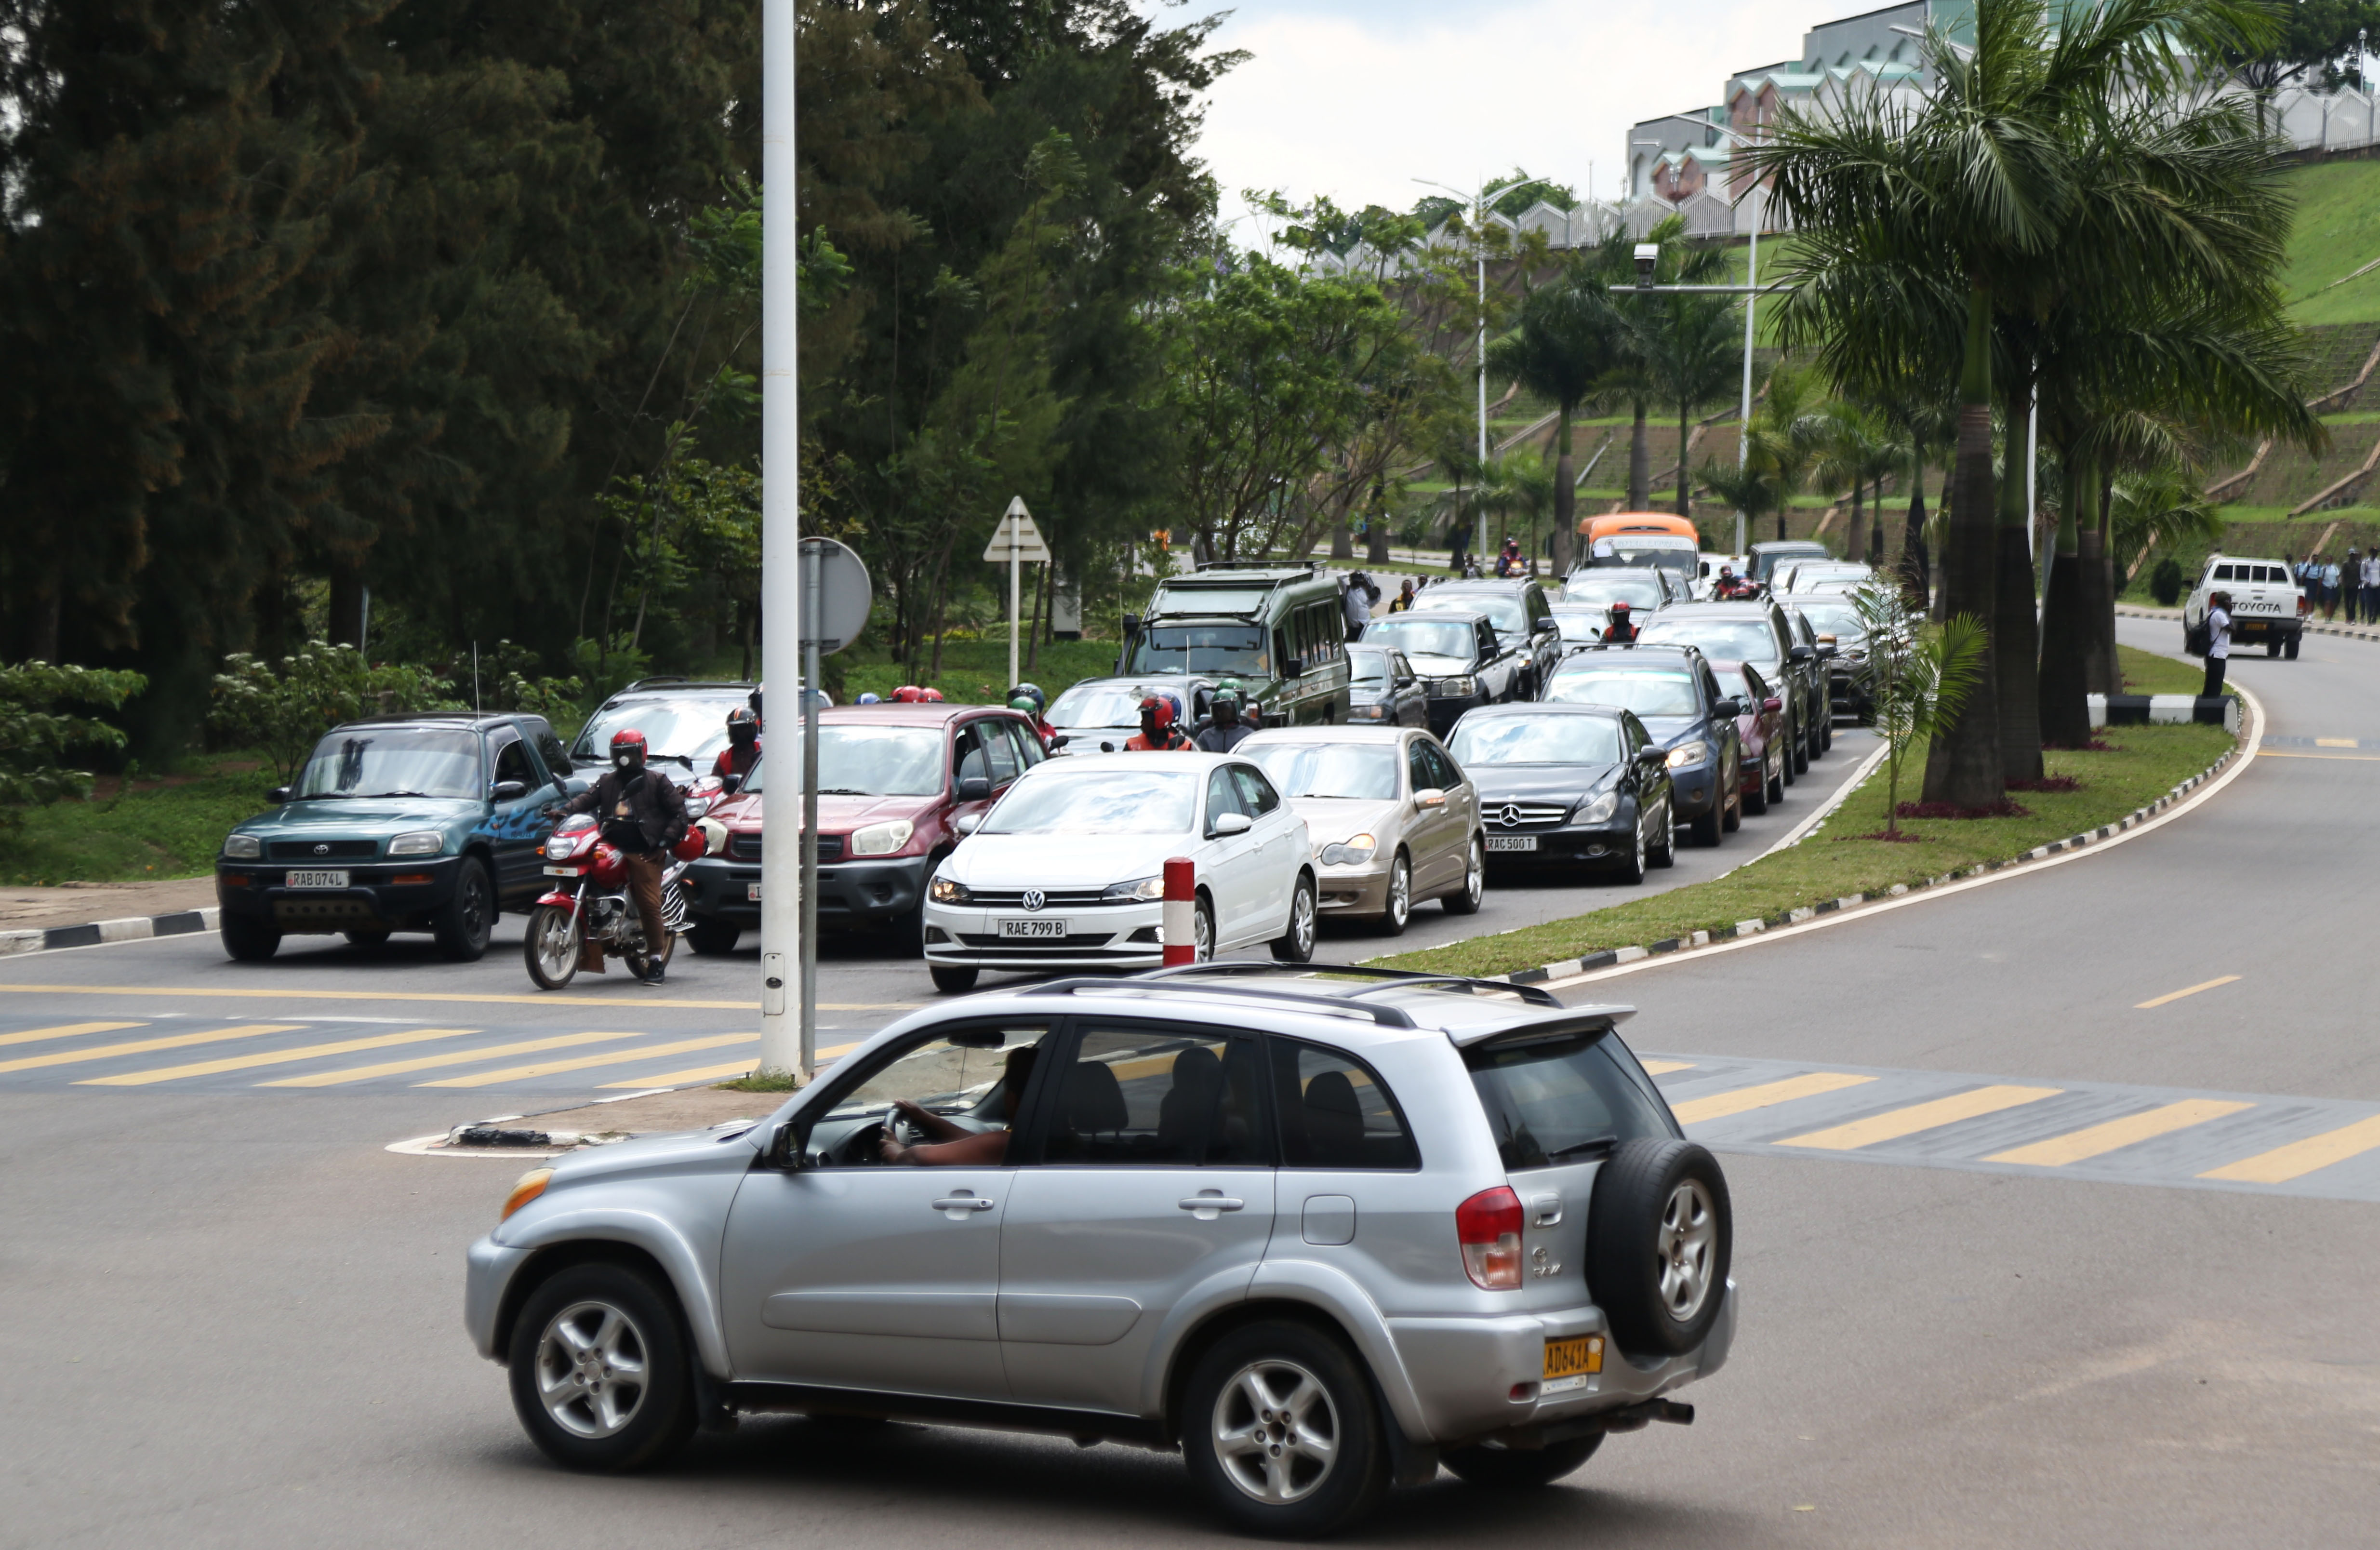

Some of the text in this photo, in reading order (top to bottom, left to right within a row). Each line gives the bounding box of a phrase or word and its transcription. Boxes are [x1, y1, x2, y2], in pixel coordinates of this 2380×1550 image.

[2231, 602, 2282, 614] TOYOTA
[1488, 839, 1532, 850] RAC 500 T
[1006, 922, 1063, 935] RAE 799 B
[1543, 1342, 1589, 1375] AD641A
